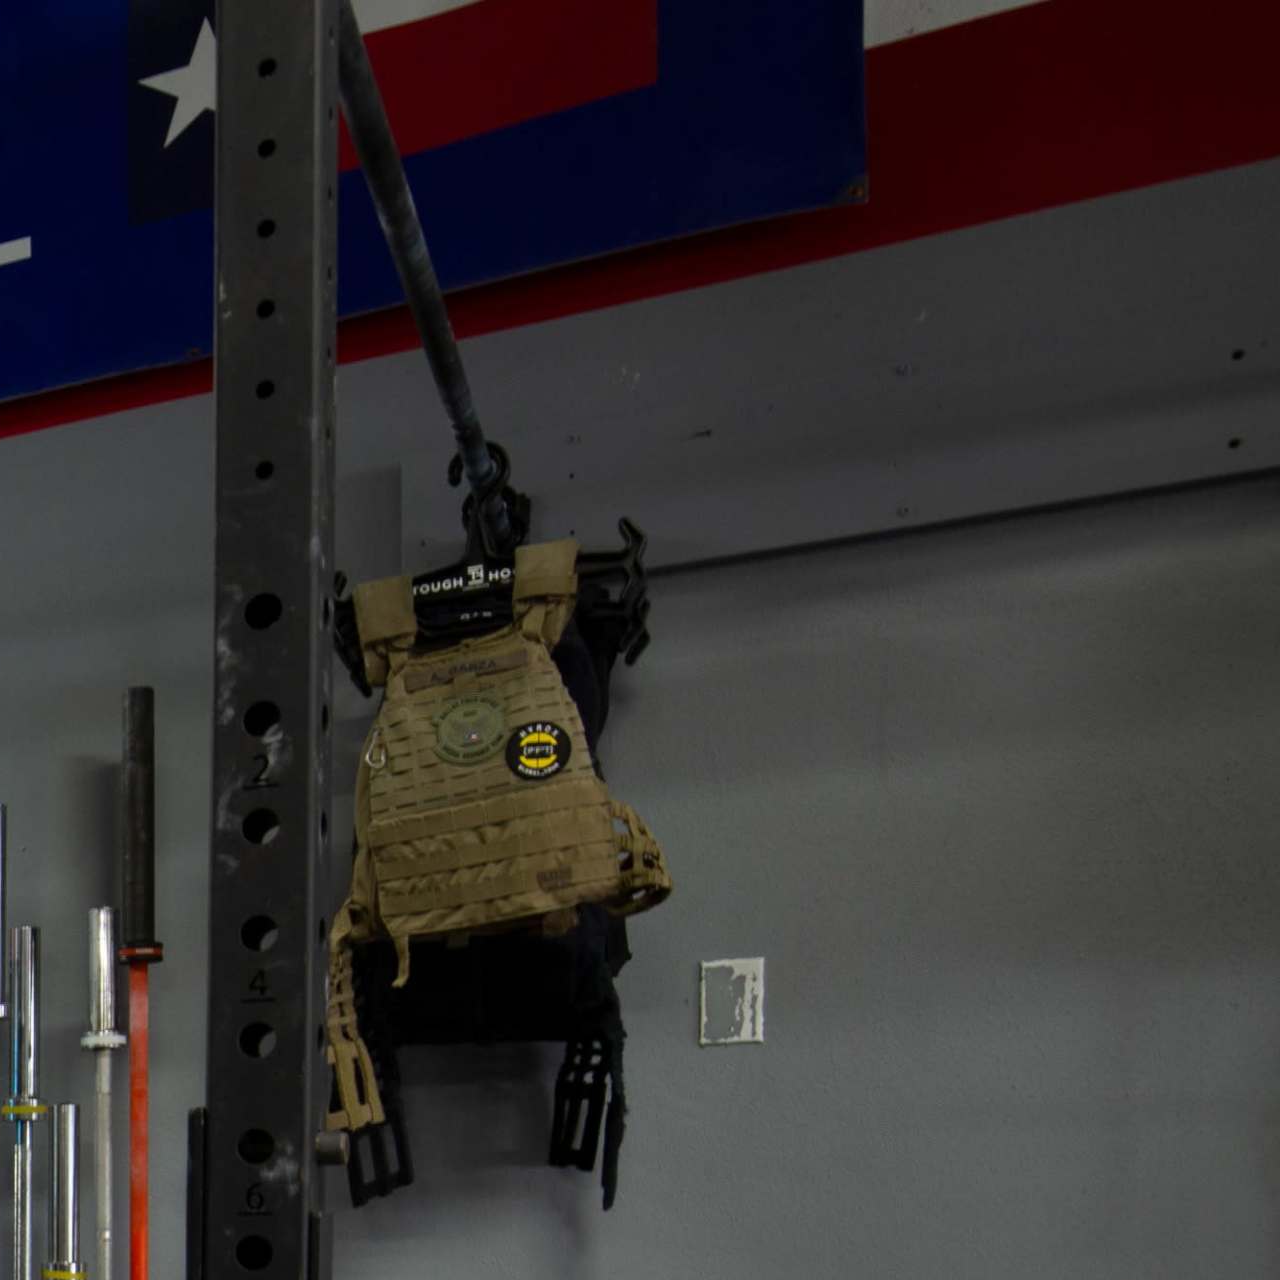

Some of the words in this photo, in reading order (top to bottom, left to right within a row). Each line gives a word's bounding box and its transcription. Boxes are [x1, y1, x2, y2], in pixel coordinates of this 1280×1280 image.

[413, 576, 463, 596] TOUGH
[488, 566, 515, 583] HO
[253, 754, 268, 783] 2
[249, 970, 267, 996] 4
[247, 1182, 264, 1210] 6
